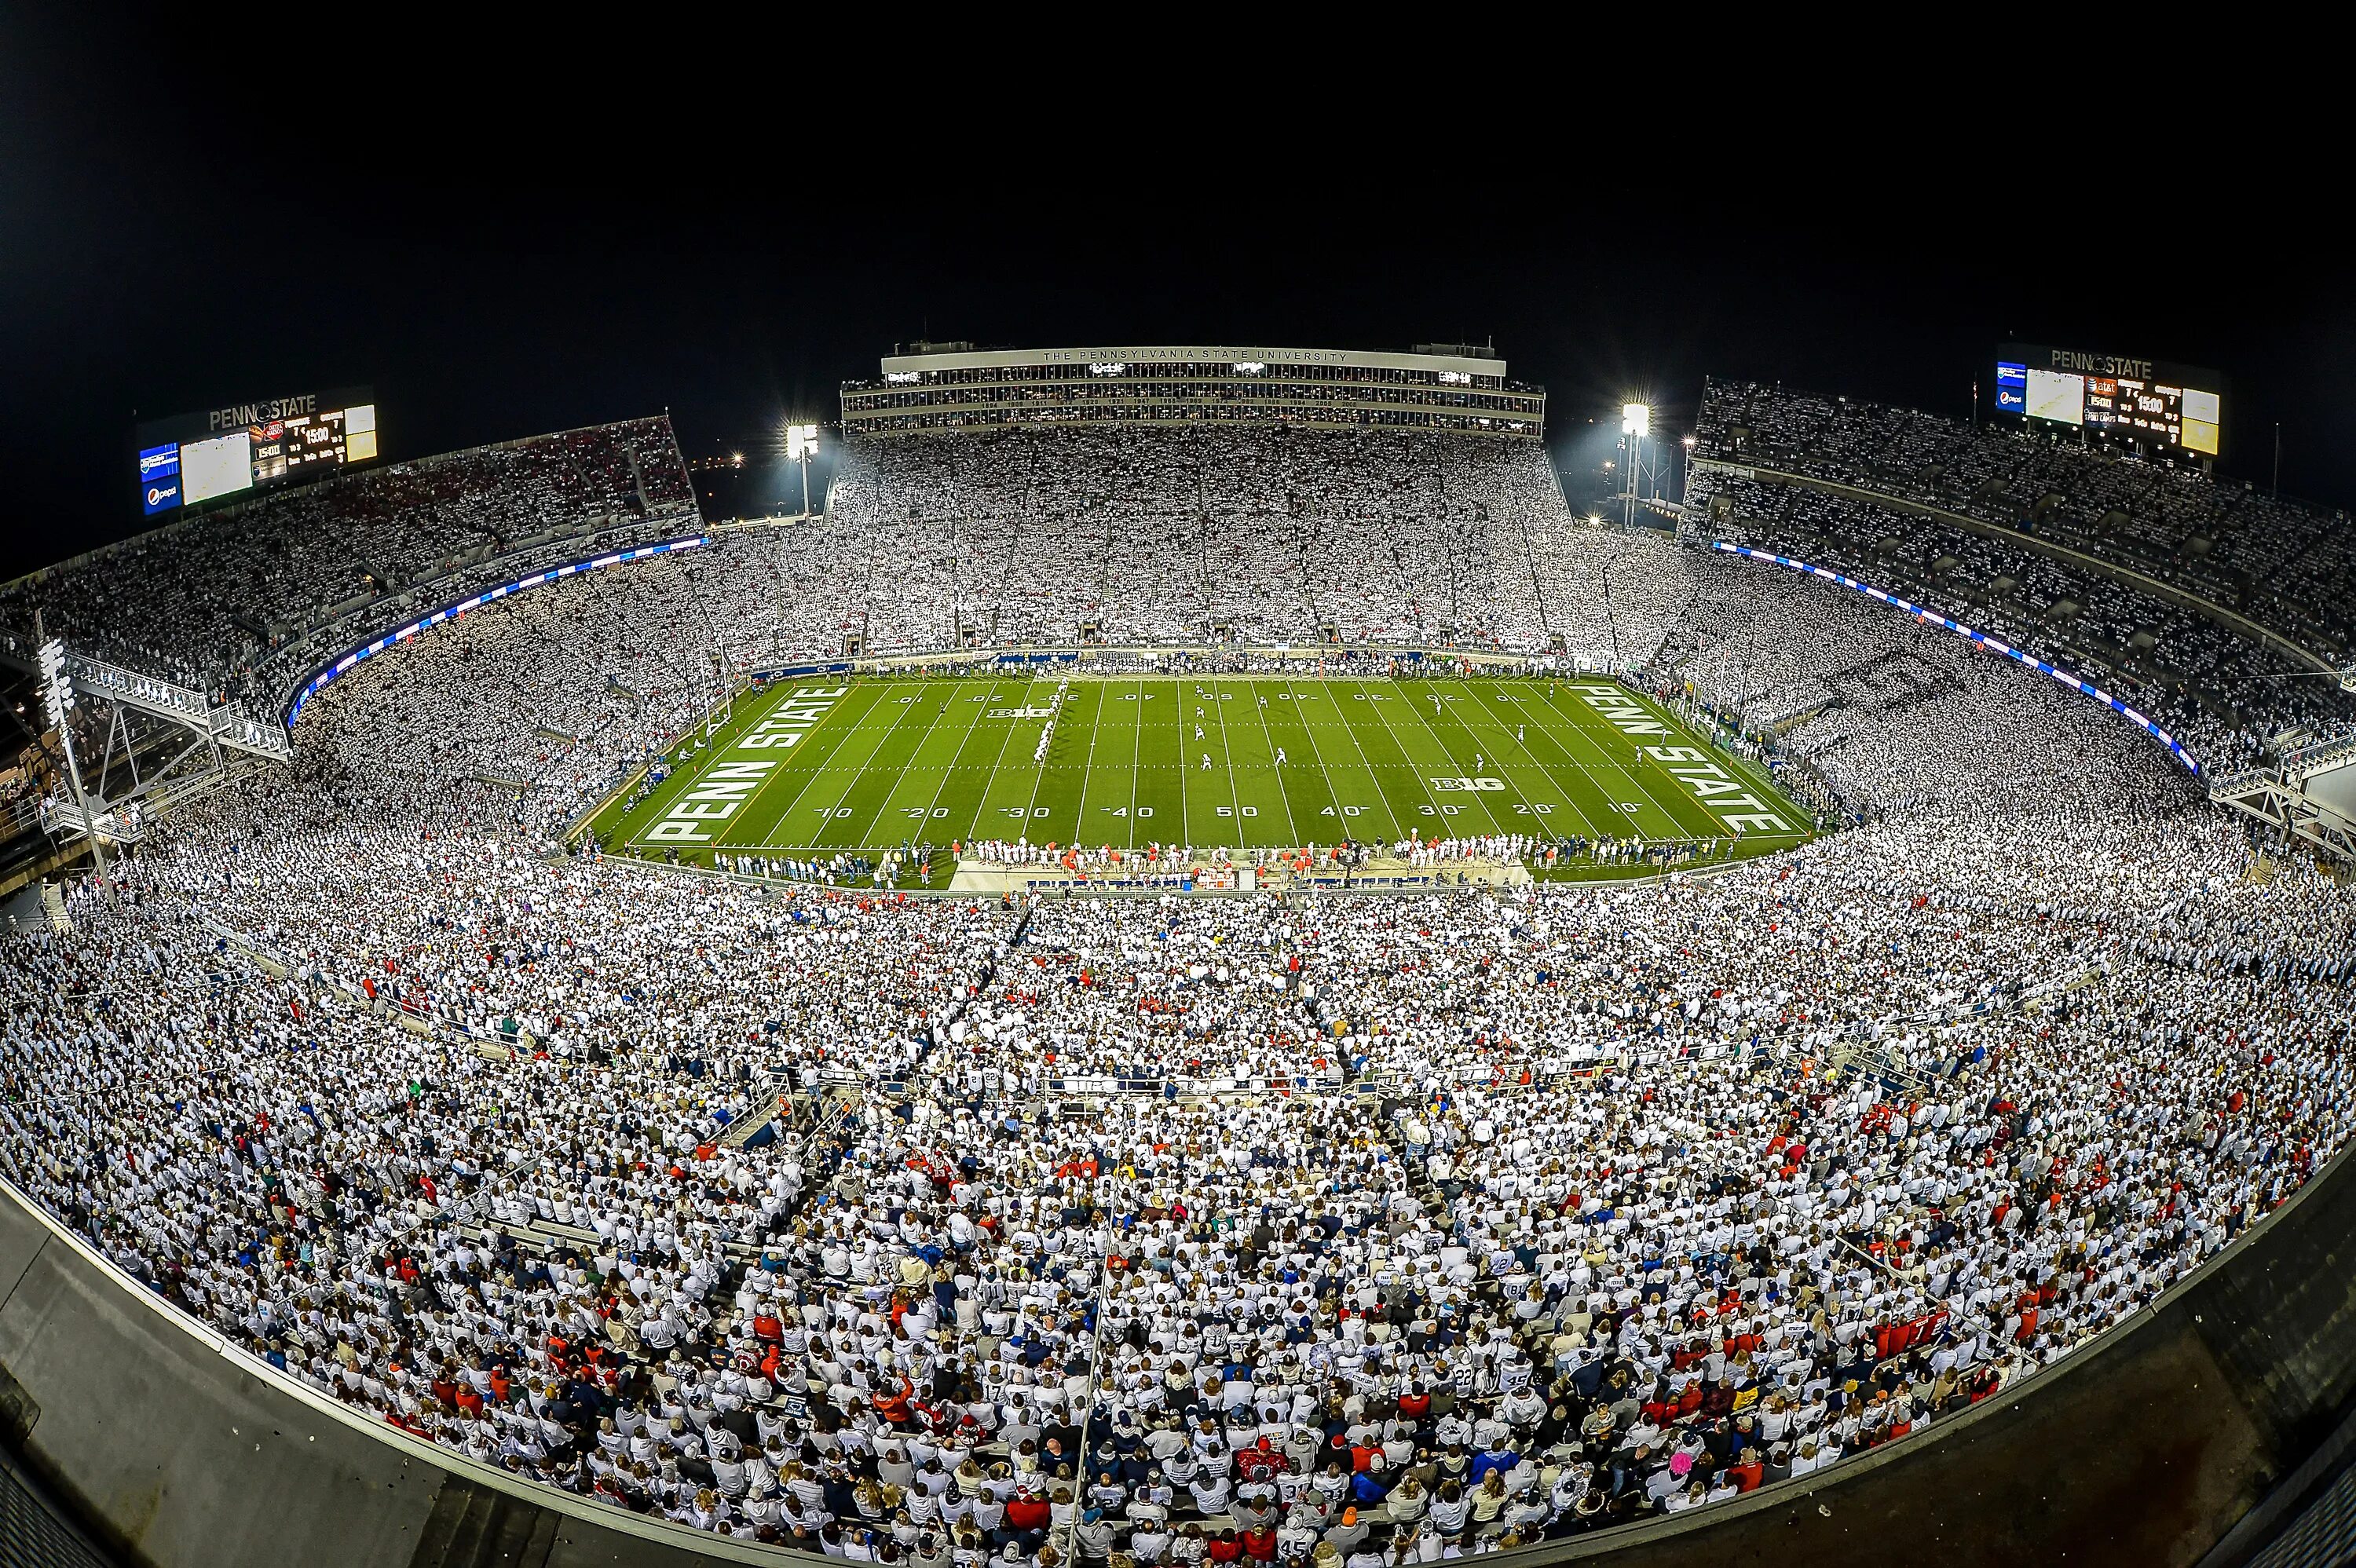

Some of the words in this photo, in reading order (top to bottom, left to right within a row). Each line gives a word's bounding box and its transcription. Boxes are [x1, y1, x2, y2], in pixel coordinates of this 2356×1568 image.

[1080, 350, 1194, 359] PENNSYLVANIA
[1202, 350, 1247, 359] STATE
[1257, 351, 1347, 361] UNIVERSITY
[2052, 349, 2092, 370] PENN
[2105, 356, 2152, 380] STATE
[2098, 382, 2115, 393] at&t
[2091, 396, 2112, 408] 15:00
[2138, 395, 2164, 413] 15:00
[210, 406, 256, 431] PENN
[271, 394, 316, 420] STATE
[305, 427, 329, 444] 15:00
[258, 445, 280, 459] 15:00
[159, 486, 177, 499] pepsi
[645, 761, 778, 841] PENN
[737, 687, 849, 749] STATE
[1568, 685, 1674, 735] PENN
[1644, 746, 1792, 832] STATE
[821, 808, 854, 818] 10
[910, 807, 949, 817] 20
[1008, 807, 1050, 817] 30
[1112, 806, 1154, 817] 40
[1216, 806, 1258, 817] 50
[1321, 806, 1361, 817] 40
[1418, 805, 1458, 816] 30
[1513, 803, 1553, 814] 20
[1608, 803, 1638, 813] 10
[1016, 1030, 1026, 1040] 22
[1019, 1240, 1033, 1250] 22
[1073, 1238, 1080, 1248] 2
[1498, 1259, 1509, 1270] 2
[989, 1285, 998, 1296] 11
[1510, 1285, 1524, 1295] 81
[1456, 1369, 1472, 1385] 22
[1507, 1376, 1527, 1387] 45
[986, 1385, 1001, 1402] 17
[1102, 1499, 1114, 1508] 2
[1281, 1540, 1306, 1558] 45
